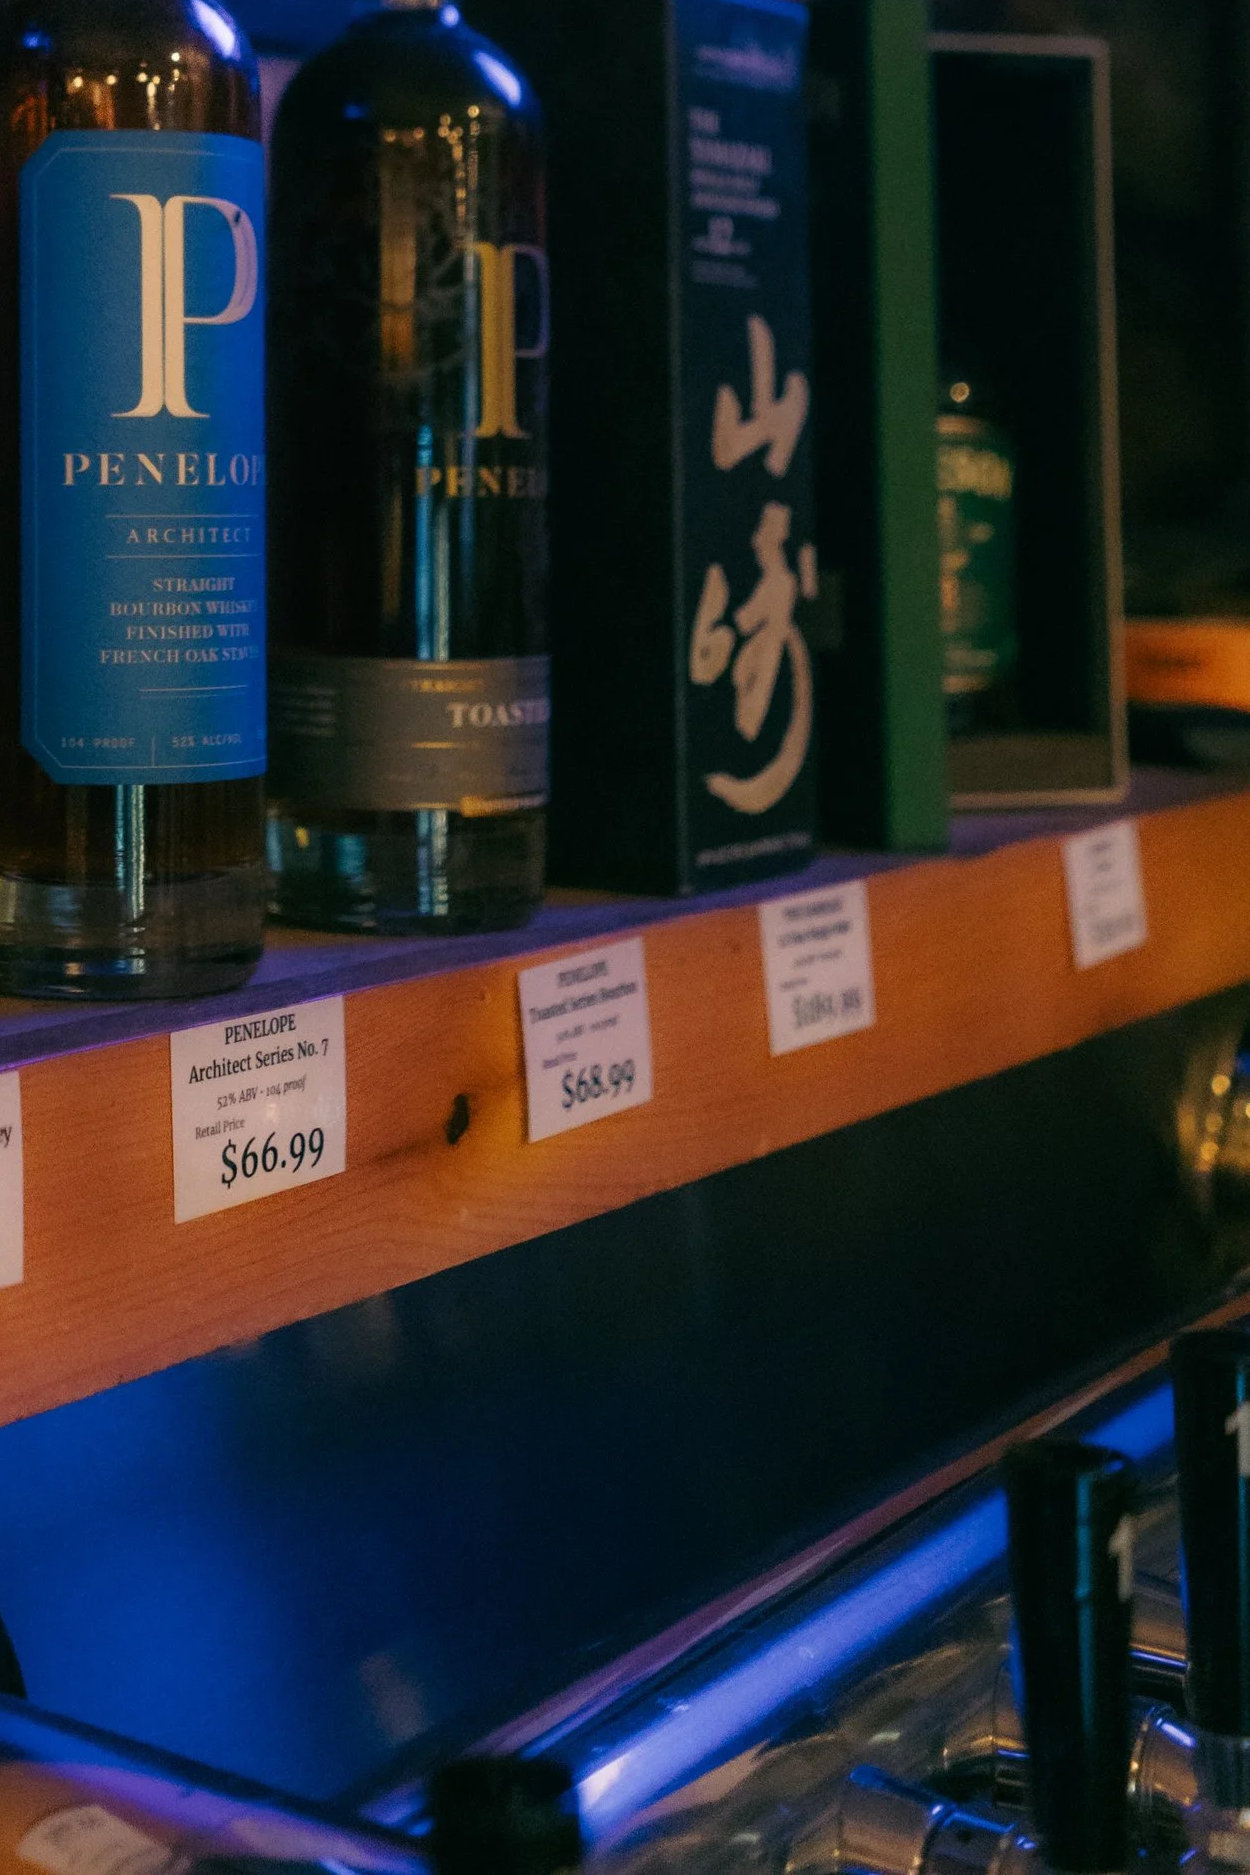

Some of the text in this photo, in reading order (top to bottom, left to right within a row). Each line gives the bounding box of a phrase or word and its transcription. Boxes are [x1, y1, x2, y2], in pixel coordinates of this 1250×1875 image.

[126, 527, 250, 544] ARCHITECT
[152, 577, 236, 593] STRAIGHT
[109, 600, 201, 616] BOURBON
[125, 624, 214, 640] FINISHED
[101, 649, 180, 665] FRENCH
[184, 646, 219, 663] OAK
[93, 736, 136, 749] PROOF
[224, 1013, 296, 1045] PENELOPE
[188, 1038, 329, 1084] Architect Series No. 7
[562, 1058, 635, 1111] $68.99
[217, 1090, 236, 1110] 52%
[239, 1086, 258, 1104] ABV
[195, 1117, 245, 1140] Retail Price
[221, 1127, 324, 1189] $66.99
